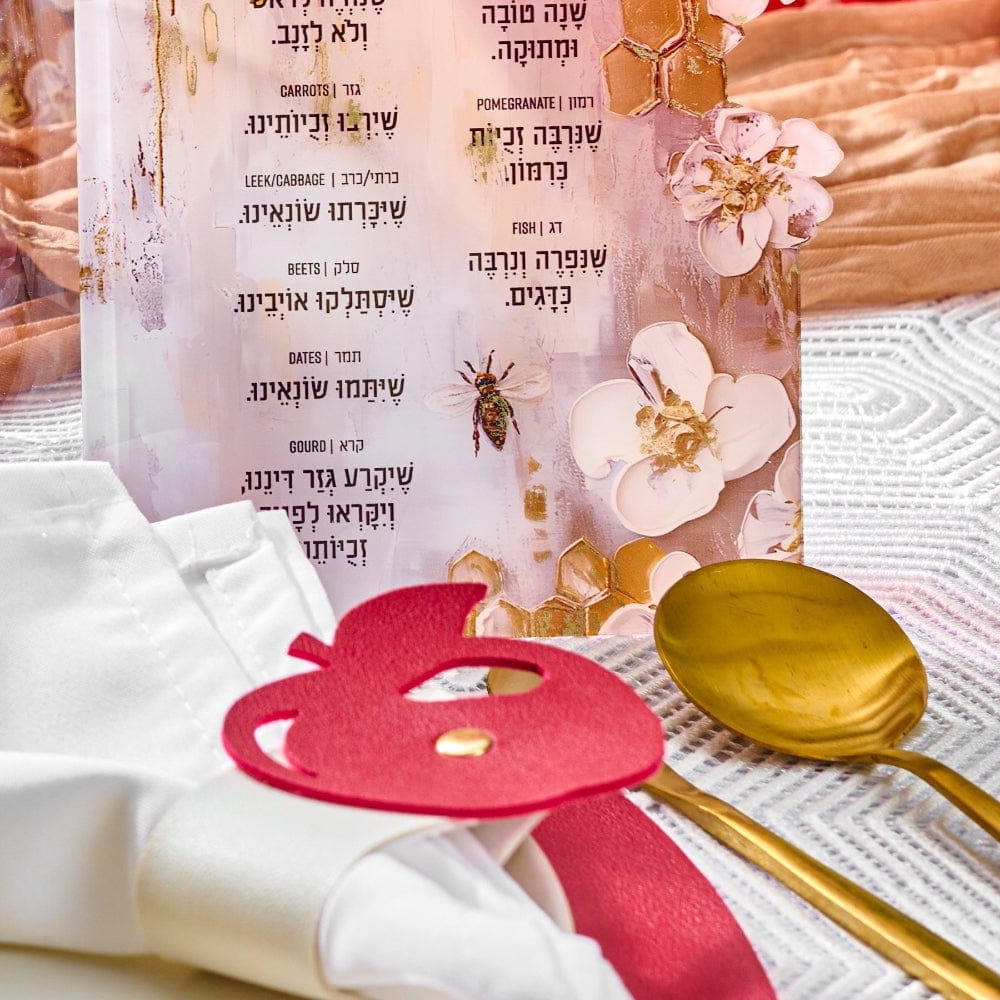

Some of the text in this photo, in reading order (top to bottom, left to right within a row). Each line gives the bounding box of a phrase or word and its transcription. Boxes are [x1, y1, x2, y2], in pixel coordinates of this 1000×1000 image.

[280, 84, 329, 98] CARROTS
[342, 83, 361, 96] גזר
[477, 97, 556, 111] POMEGRANATE
[568, 96, 594, 110] רמון
[245, 173, 325, 188] LEEK/CABBAGE
[341, 169, 400, 187] כרתי/כרב
[512, 222, 536, 235] FISH
[548, 221, 563, 234] דג
[287, 262, 321, 276] BEETS
[334, 260, 360, 277] סלק
[289, 351, 322, 365] DATES
[334, 351, 361, 363] תמר
[289, 440, 327, 454] GOURD
[340, 439, 364, 454] קרא
